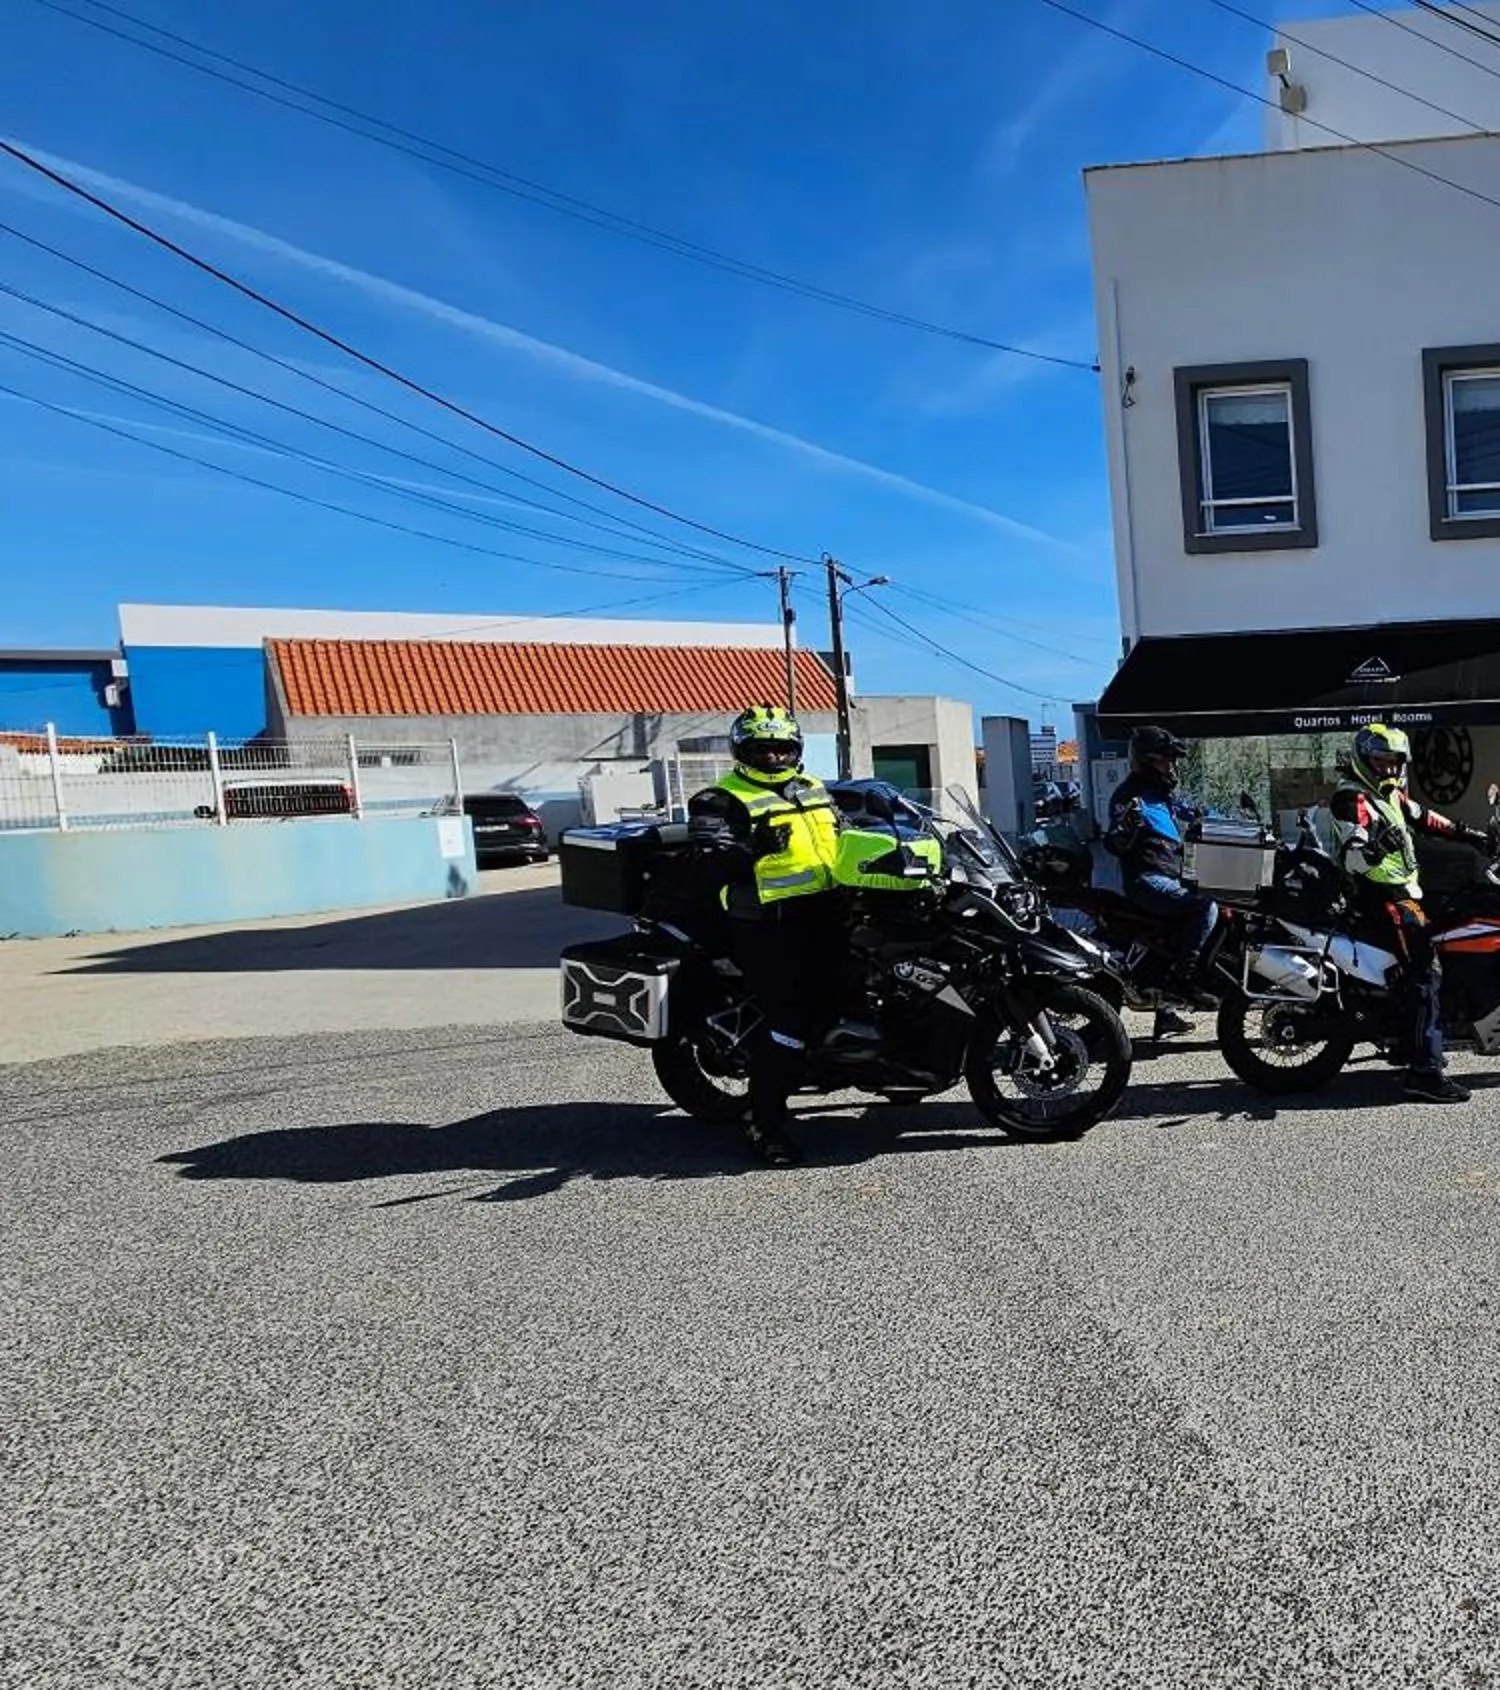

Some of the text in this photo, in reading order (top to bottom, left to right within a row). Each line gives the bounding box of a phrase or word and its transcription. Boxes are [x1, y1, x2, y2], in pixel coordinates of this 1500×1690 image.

[1294, 711, 1433, 729] Quartos Hotel Rooms
